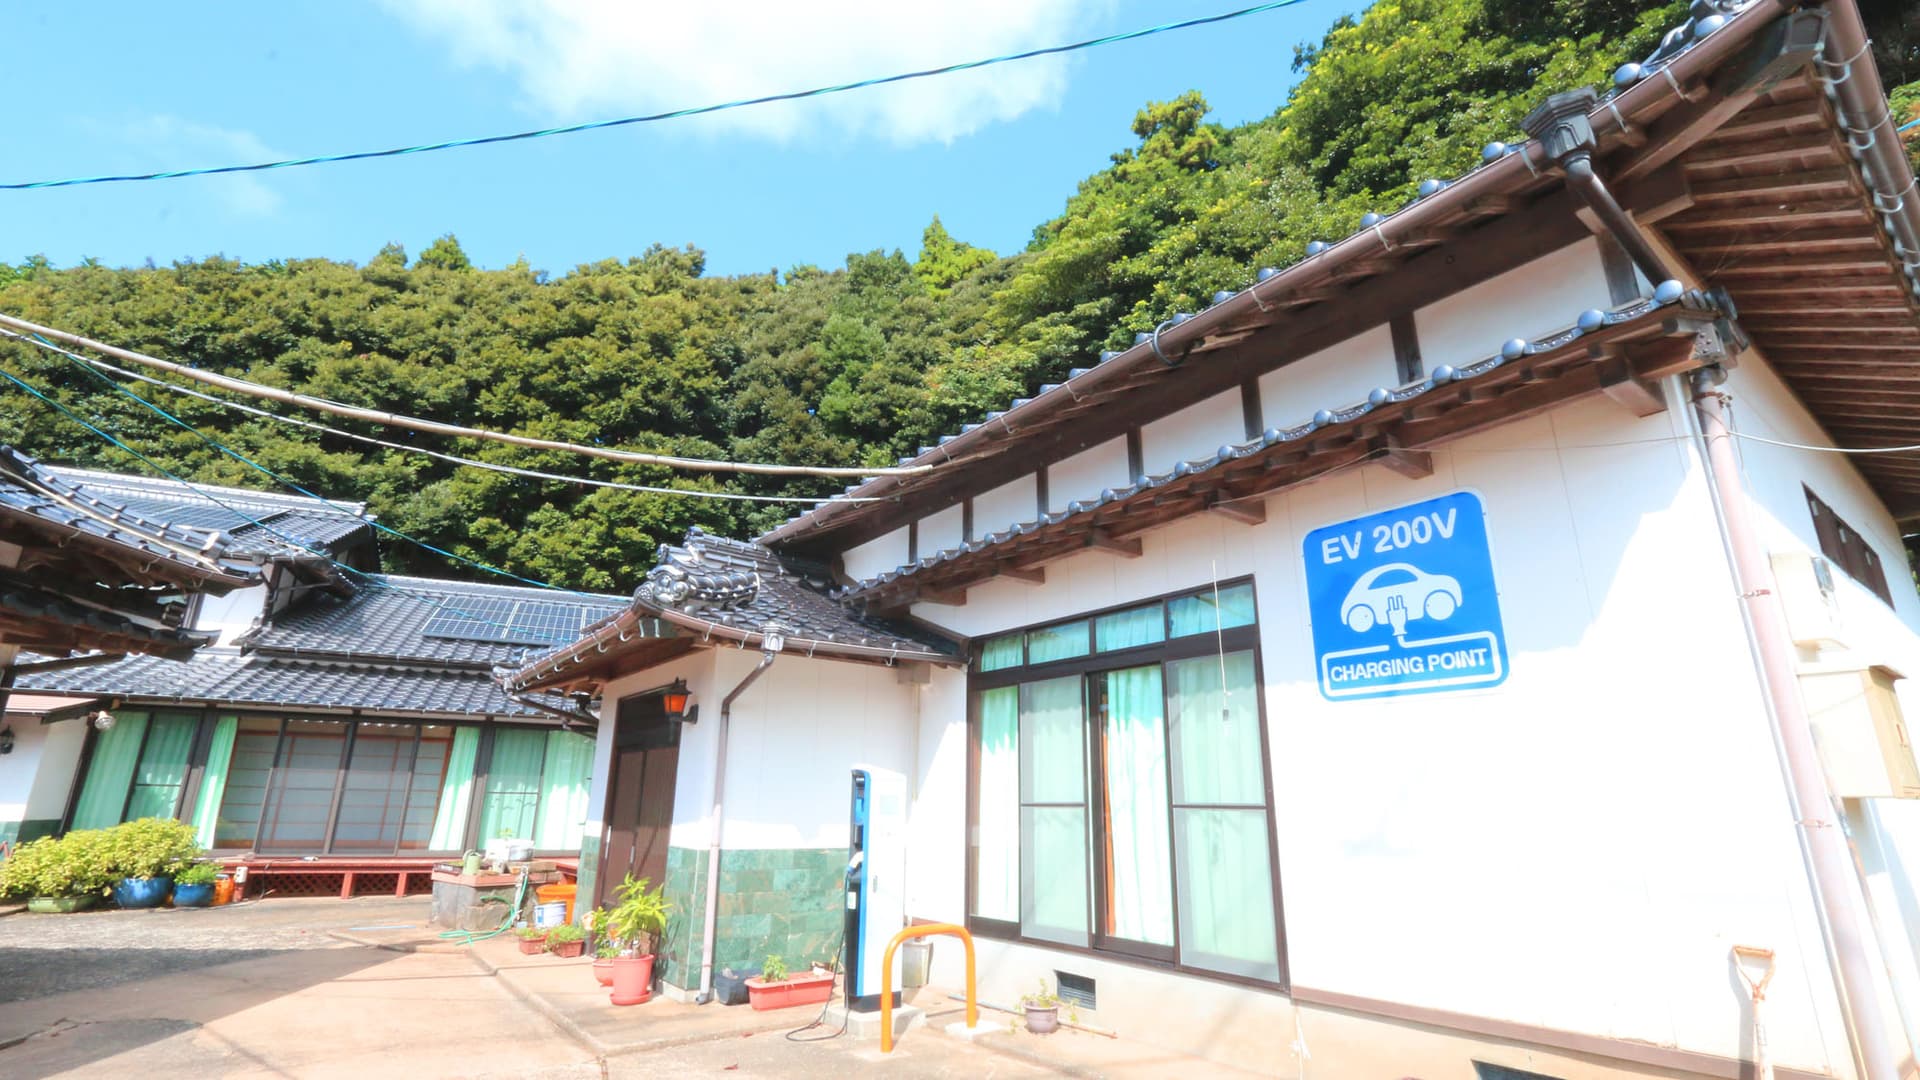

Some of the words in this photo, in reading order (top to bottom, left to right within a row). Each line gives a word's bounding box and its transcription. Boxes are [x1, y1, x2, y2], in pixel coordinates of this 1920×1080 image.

[1322, 531, 1362, 564] EV
[1373, 508, 1456, 553] 200V
[1330, 657, 1424, 682] CHARGING
[1428, 648, 1488, 671] POINT
